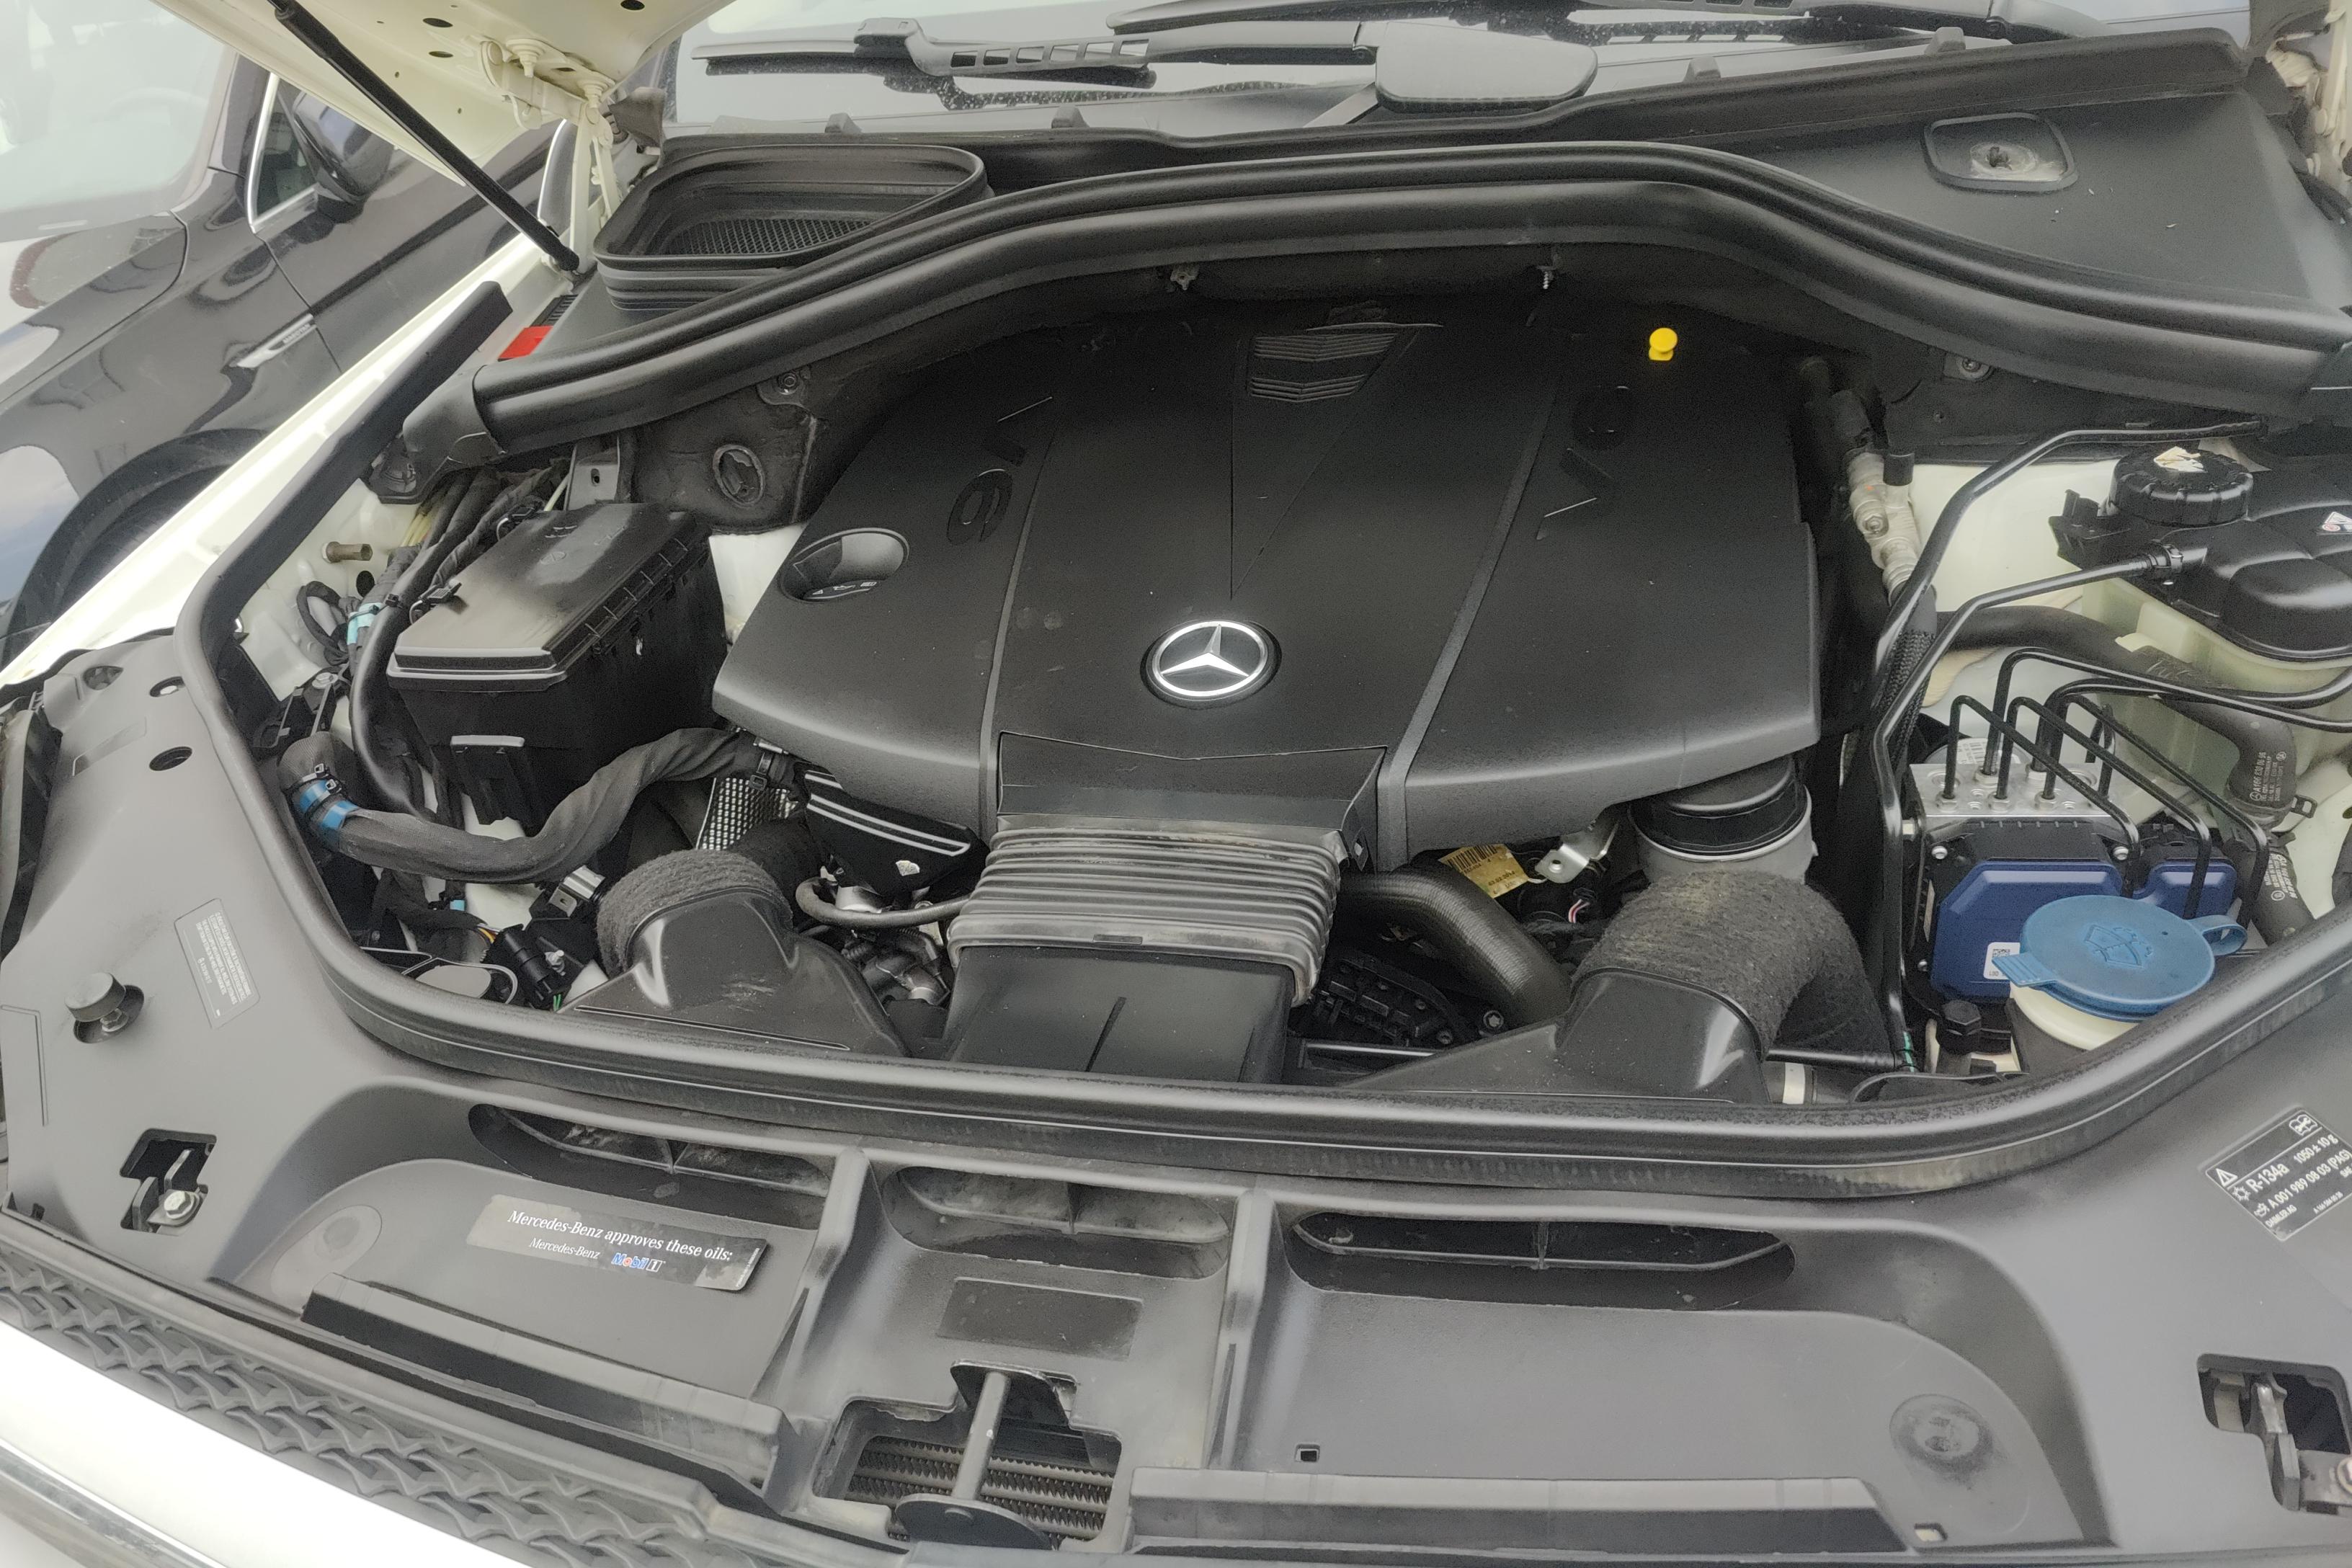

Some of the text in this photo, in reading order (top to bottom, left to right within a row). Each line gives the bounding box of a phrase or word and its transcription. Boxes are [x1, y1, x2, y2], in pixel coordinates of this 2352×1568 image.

[2245, 1162, 2290, 1193] R-134a
[2294, 1147, 2315, 1164] 1050
[2317, 1136, 2330, 1148] 10
[2268, 1198, 2279, 1209] A
[2274, 1188, 2294, 1203] 001
[2289, 1177, 2308, 1194] 989
[2306, 1170, 2320, 1183] 08
[2317, 1163, 2331, 1176] 03
[507, 1210, 733, 1261] Mercedes-Benz approves these oils:
[529, 1237, 600, 1260] Mercedes-Benz
[611, 1252, 649, 1270] Mobil
